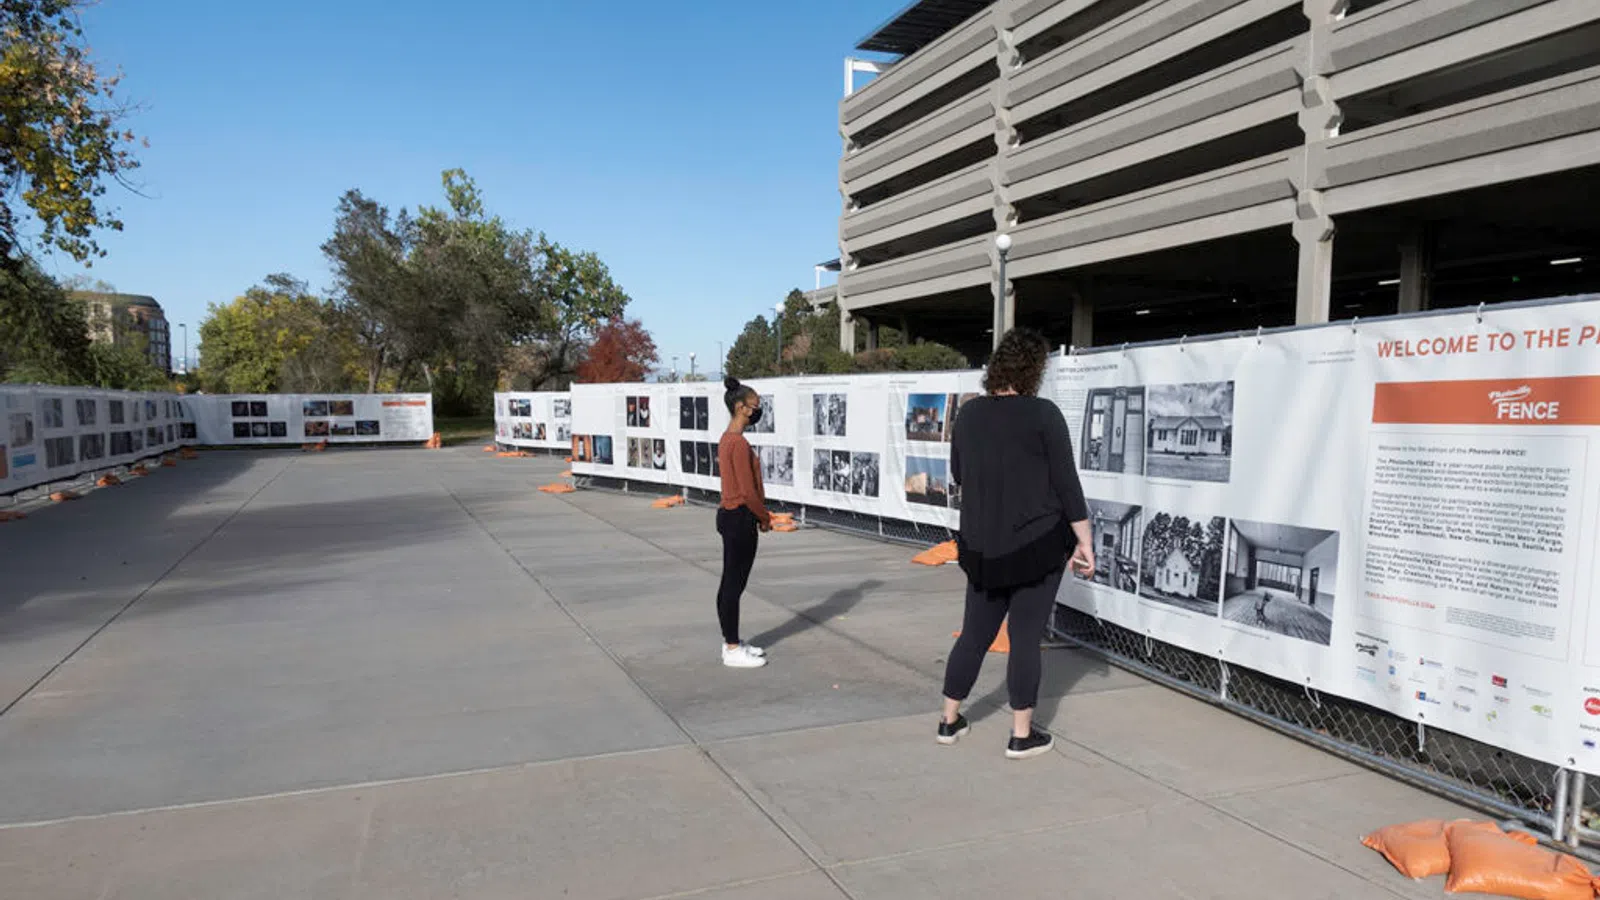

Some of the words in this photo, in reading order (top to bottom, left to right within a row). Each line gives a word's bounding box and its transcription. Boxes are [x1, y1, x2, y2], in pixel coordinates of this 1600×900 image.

[1377, 334, 1479, 357] WELCOME
[1487, 332, 1516, 351] TO
[1523, 327, 1570, 349] THE
[1577, 325, 1600, 346] P
[1497, 401, 1560, 419] FENCE
